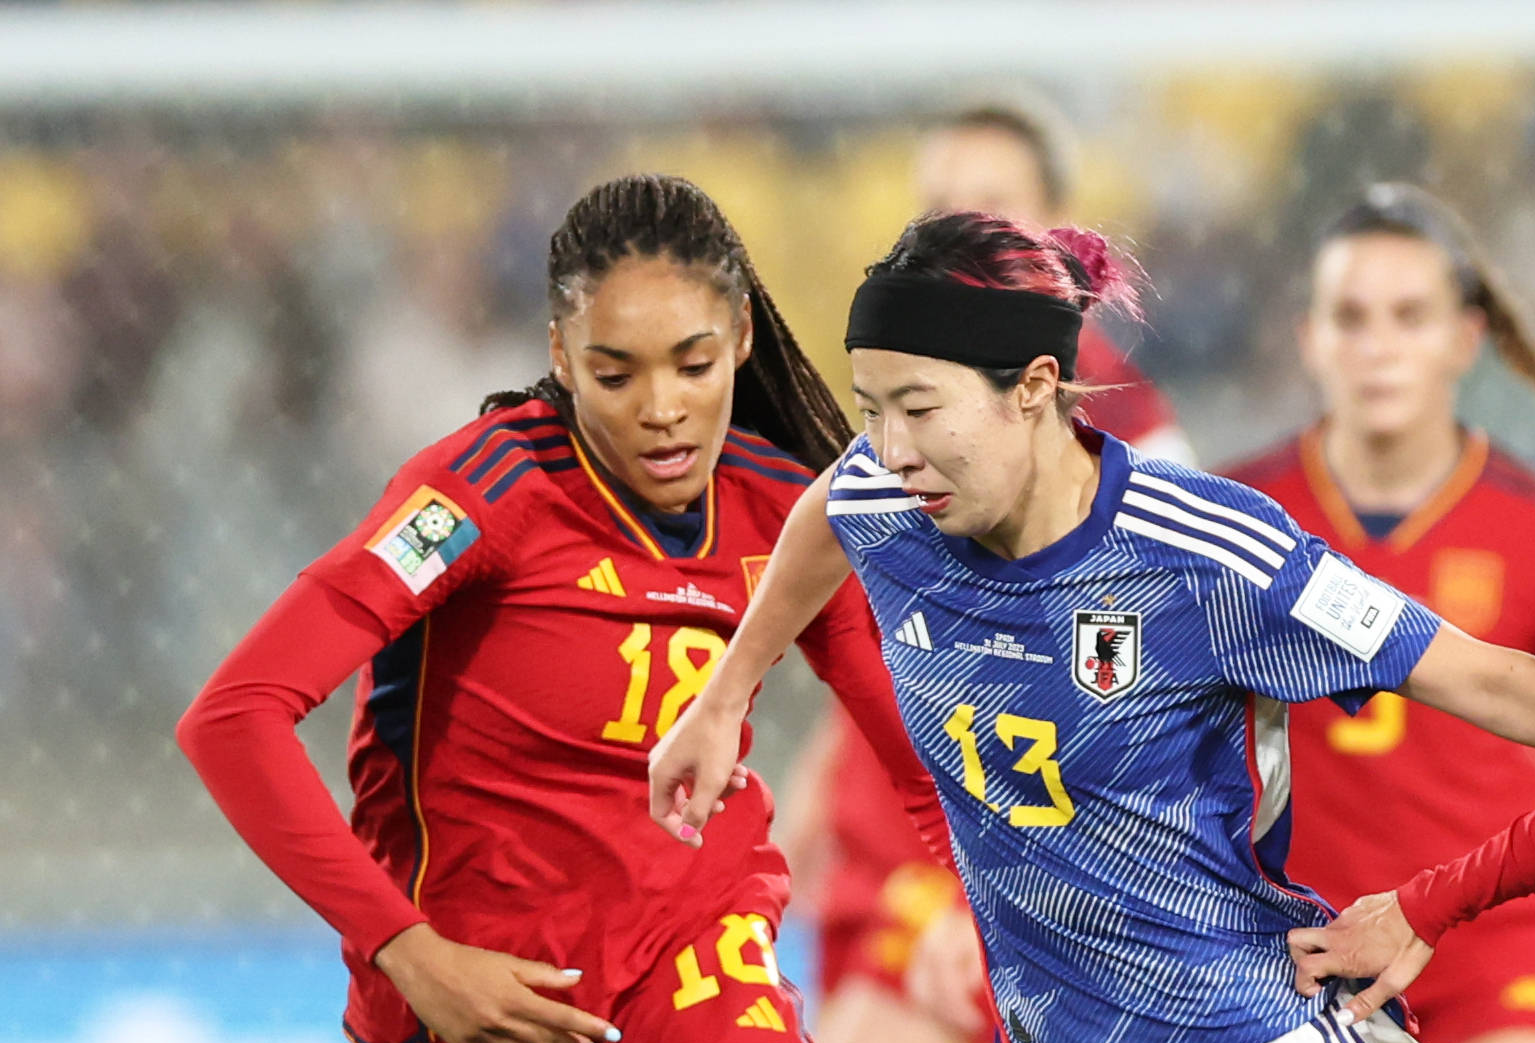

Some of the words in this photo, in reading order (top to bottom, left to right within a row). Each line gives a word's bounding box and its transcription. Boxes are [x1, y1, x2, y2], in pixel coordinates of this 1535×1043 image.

[1326, 579, 1358, 620] UNITES
[1090, 615, 1125, 624] JAPAN
[954, 641, 993, 655] WELLINGTON
[993, 648, 1024, 660] REGIONAL
[1024, 652, 1053, 664] STADIUM
[993, 640, 1008, 650] JULY
[602, 622, 729, 743] 18
[943, 704, 1076, 827] 13
